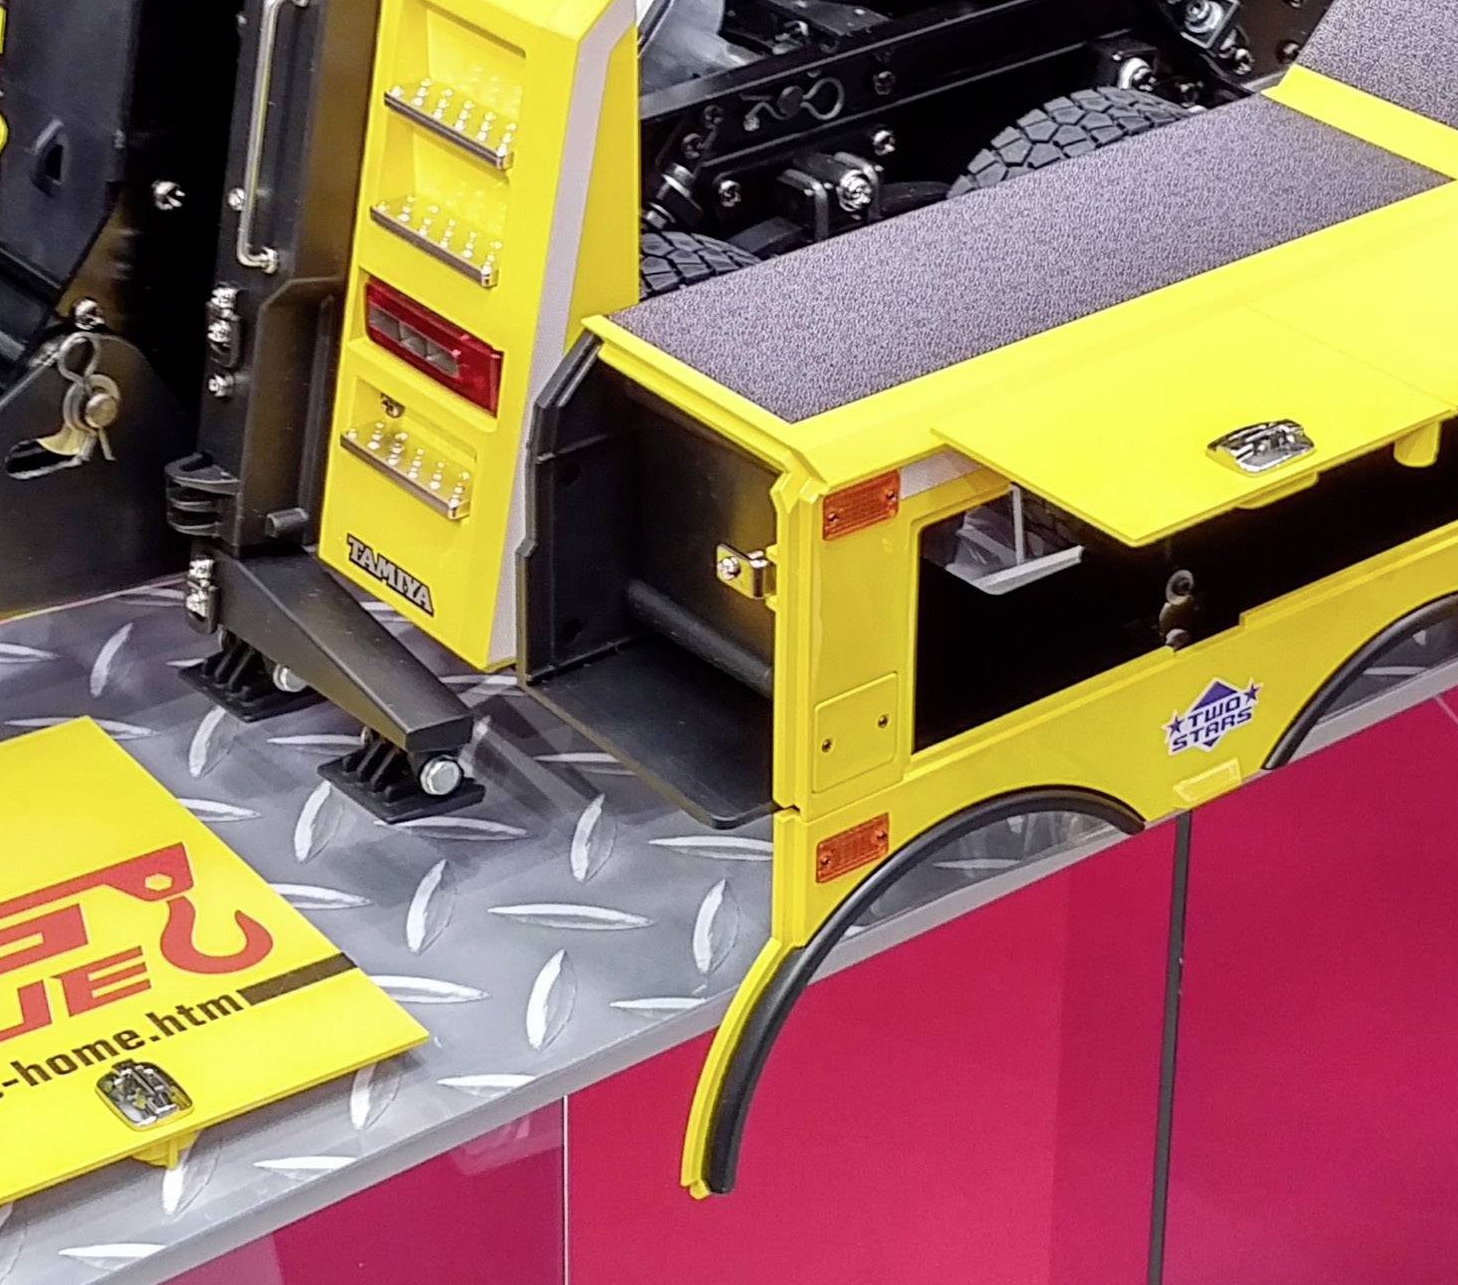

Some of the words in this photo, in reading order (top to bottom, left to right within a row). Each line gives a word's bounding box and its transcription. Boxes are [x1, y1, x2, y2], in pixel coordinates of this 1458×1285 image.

[346, 532, 434, 617] TAMIYA
[1171, 706, 1252, 752] STARS
[1187, 696, 1241, 727] TWO
